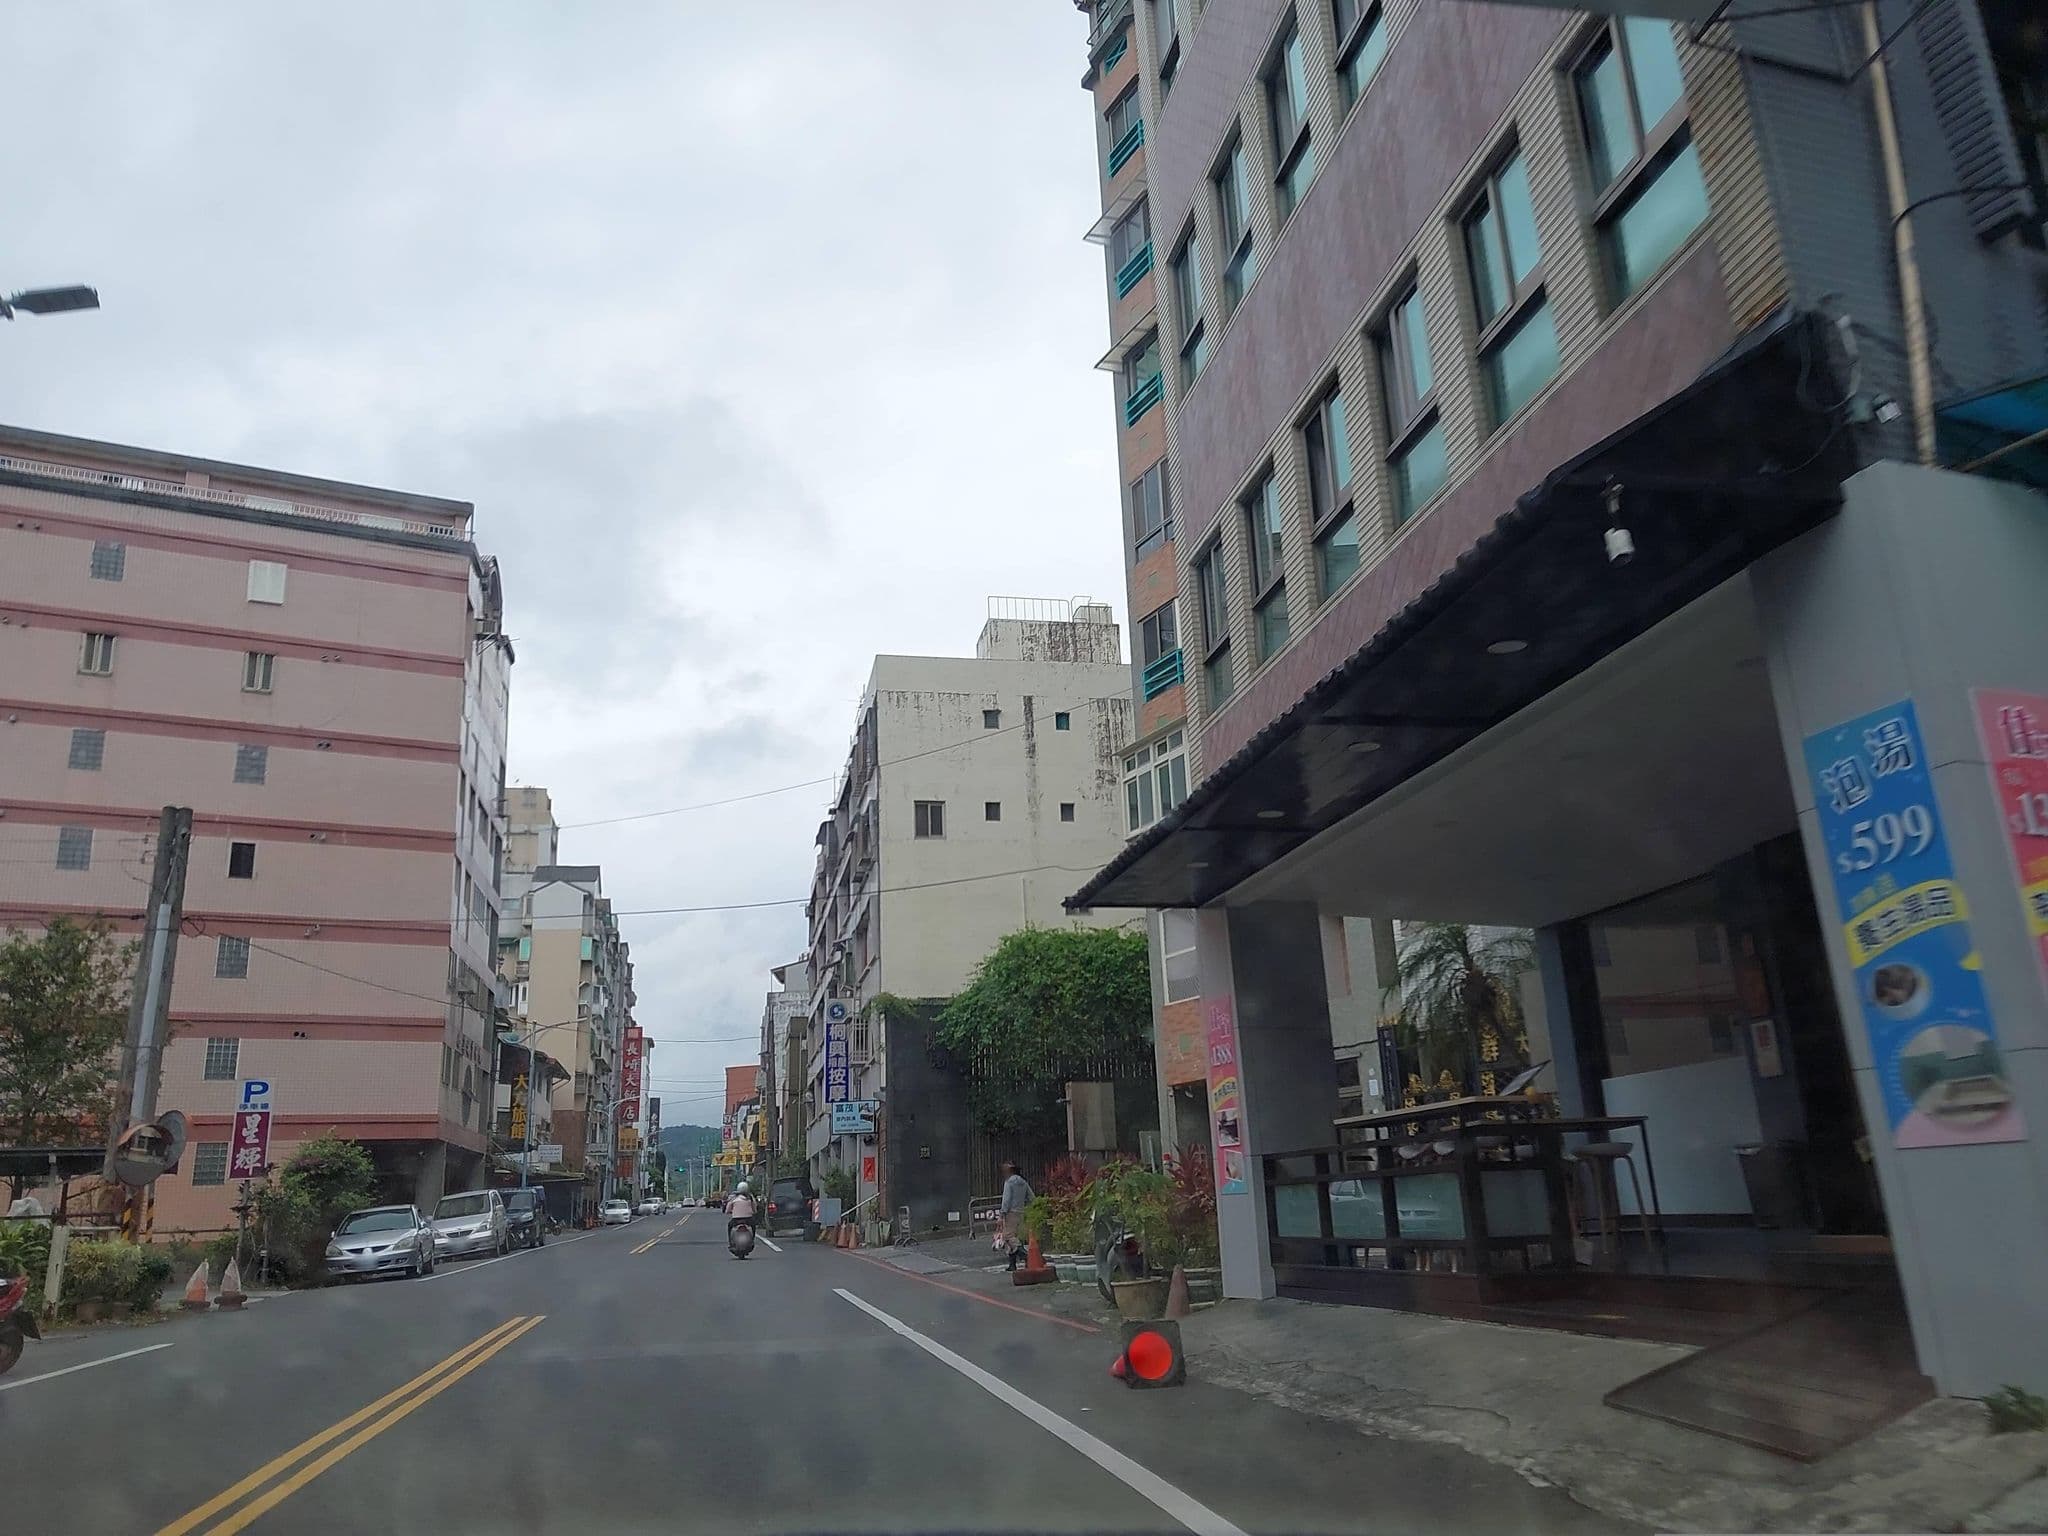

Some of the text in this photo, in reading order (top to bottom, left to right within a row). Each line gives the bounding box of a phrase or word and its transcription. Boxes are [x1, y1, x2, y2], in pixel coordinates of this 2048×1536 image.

[1819, 716, 1914, 815] 泡湯
[1837, 804, 1934, 873] $599
[244, 1082, 269, 1104] P
